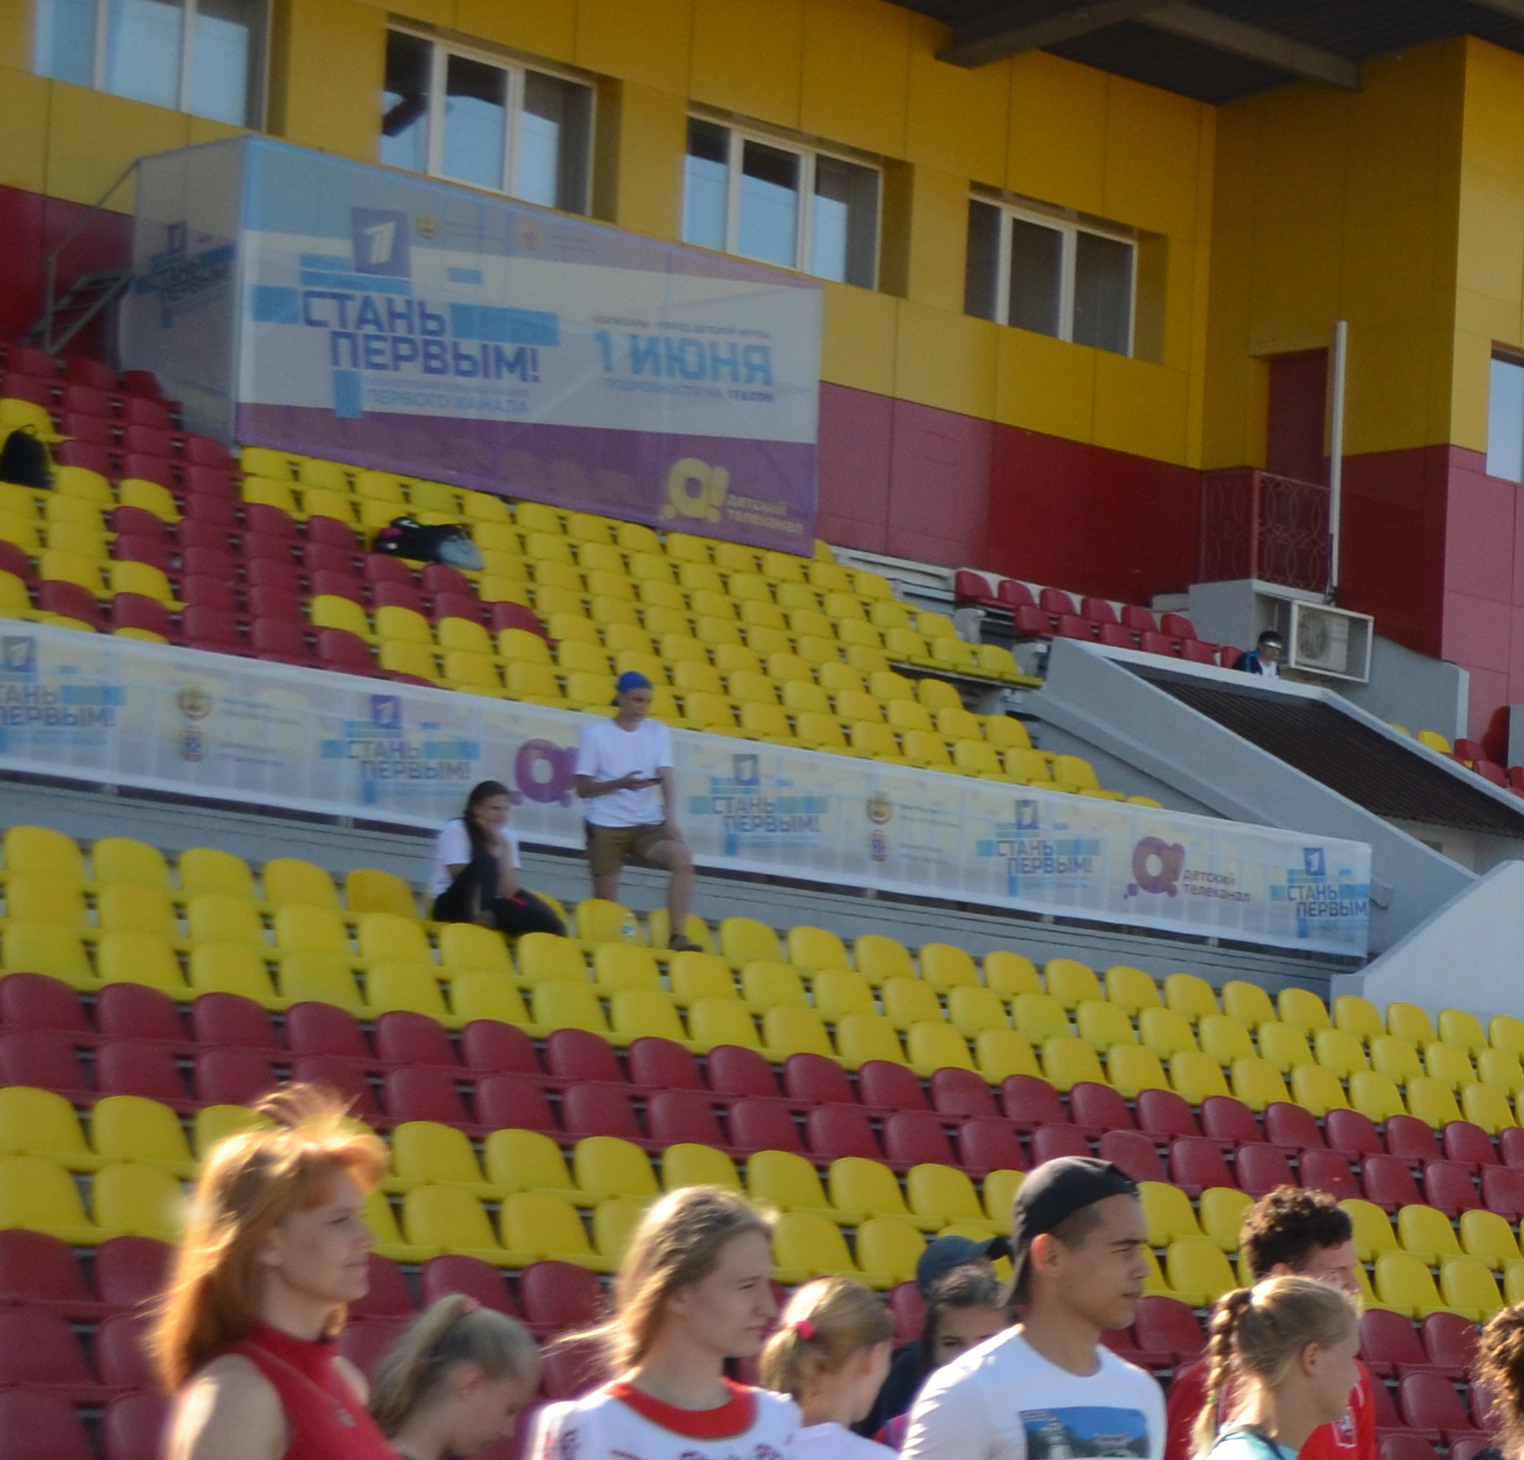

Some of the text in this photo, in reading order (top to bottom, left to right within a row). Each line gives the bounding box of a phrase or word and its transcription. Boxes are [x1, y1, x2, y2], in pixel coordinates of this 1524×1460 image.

[302, 289, 447, 338] СТАНЬ
[330, 330, 541, 384] ПЕРВЫМ!
[593, 330, 773, 386] 1 ИЮНЯ
[0, 685, 60, 706] ТАНЬ
[349, 740, 421, 760] СТАНЬ
[361, 760, 471, 780] ПЕРВЫМ!
[711, 795, 775, 815] СТАНЬ
[723, 814, 820, 833] ПЕРВЫМ!
[996, 838, 1054, 857] СТАНЬ
[1007, 856, 1093, 876] ПЕРВЫМ!
[1287, 884, 1338, 901] СТАНЬ
